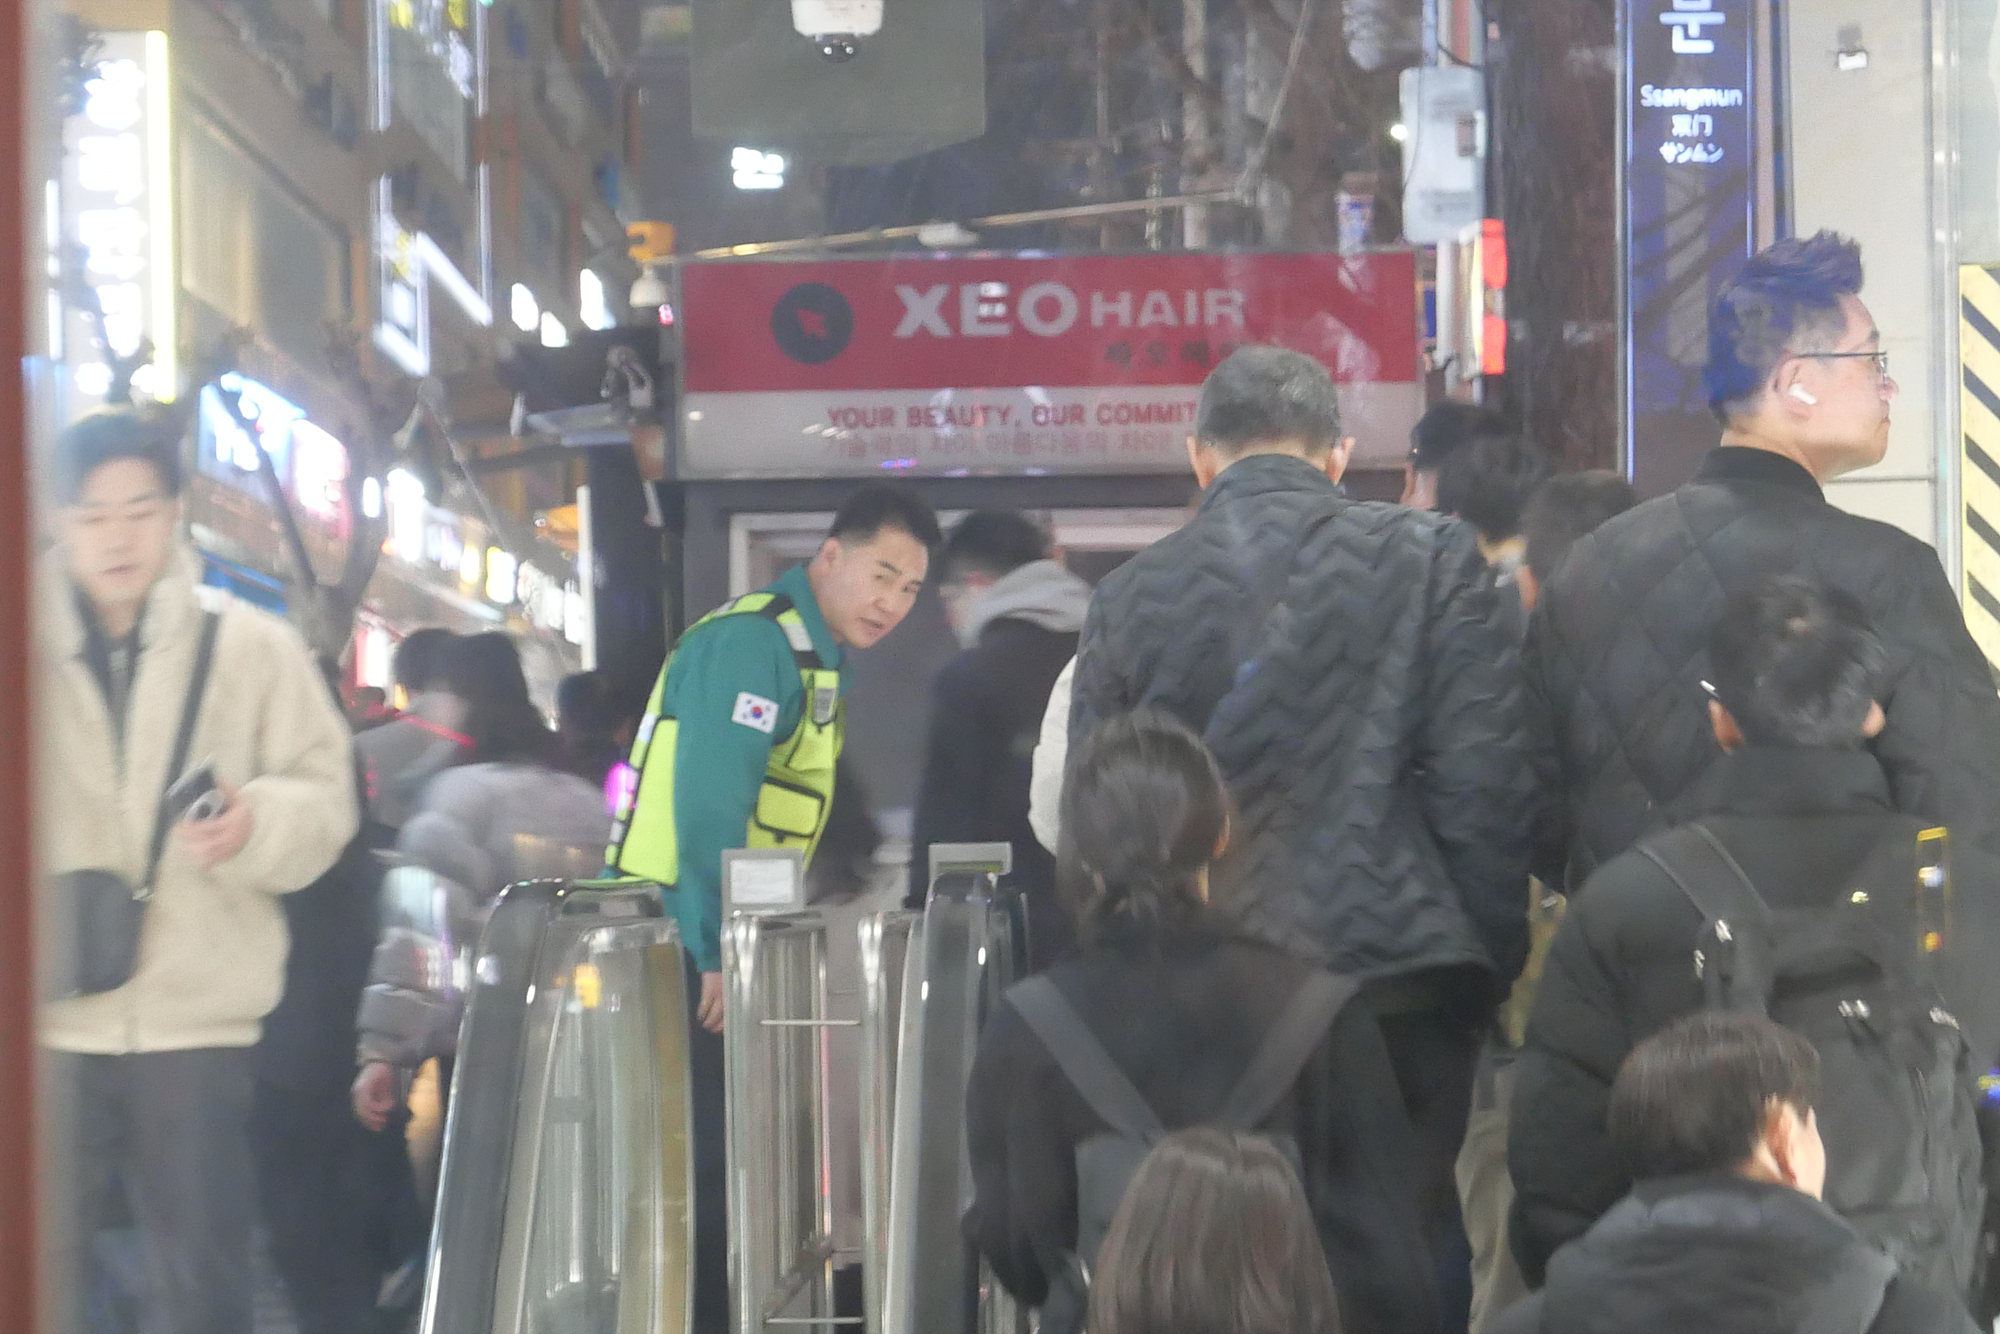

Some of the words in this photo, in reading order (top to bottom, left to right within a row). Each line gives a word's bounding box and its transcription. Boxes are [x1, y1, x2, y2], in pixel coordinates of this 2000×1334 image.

[1659, 0, 1726, 54] 문
[1640, 84, 1743, 111] Ssangmun
[893, 281, 1078, 338] XEO
[1090, 288, 1246, 328] HAIR
[827, 406, 894, 428] YOUR
[907, 404, 1021, 428] BEAUTY,
[1032, 402, 1085, 426] OUR
[1096, 400, 1197, 425] COMMIT
